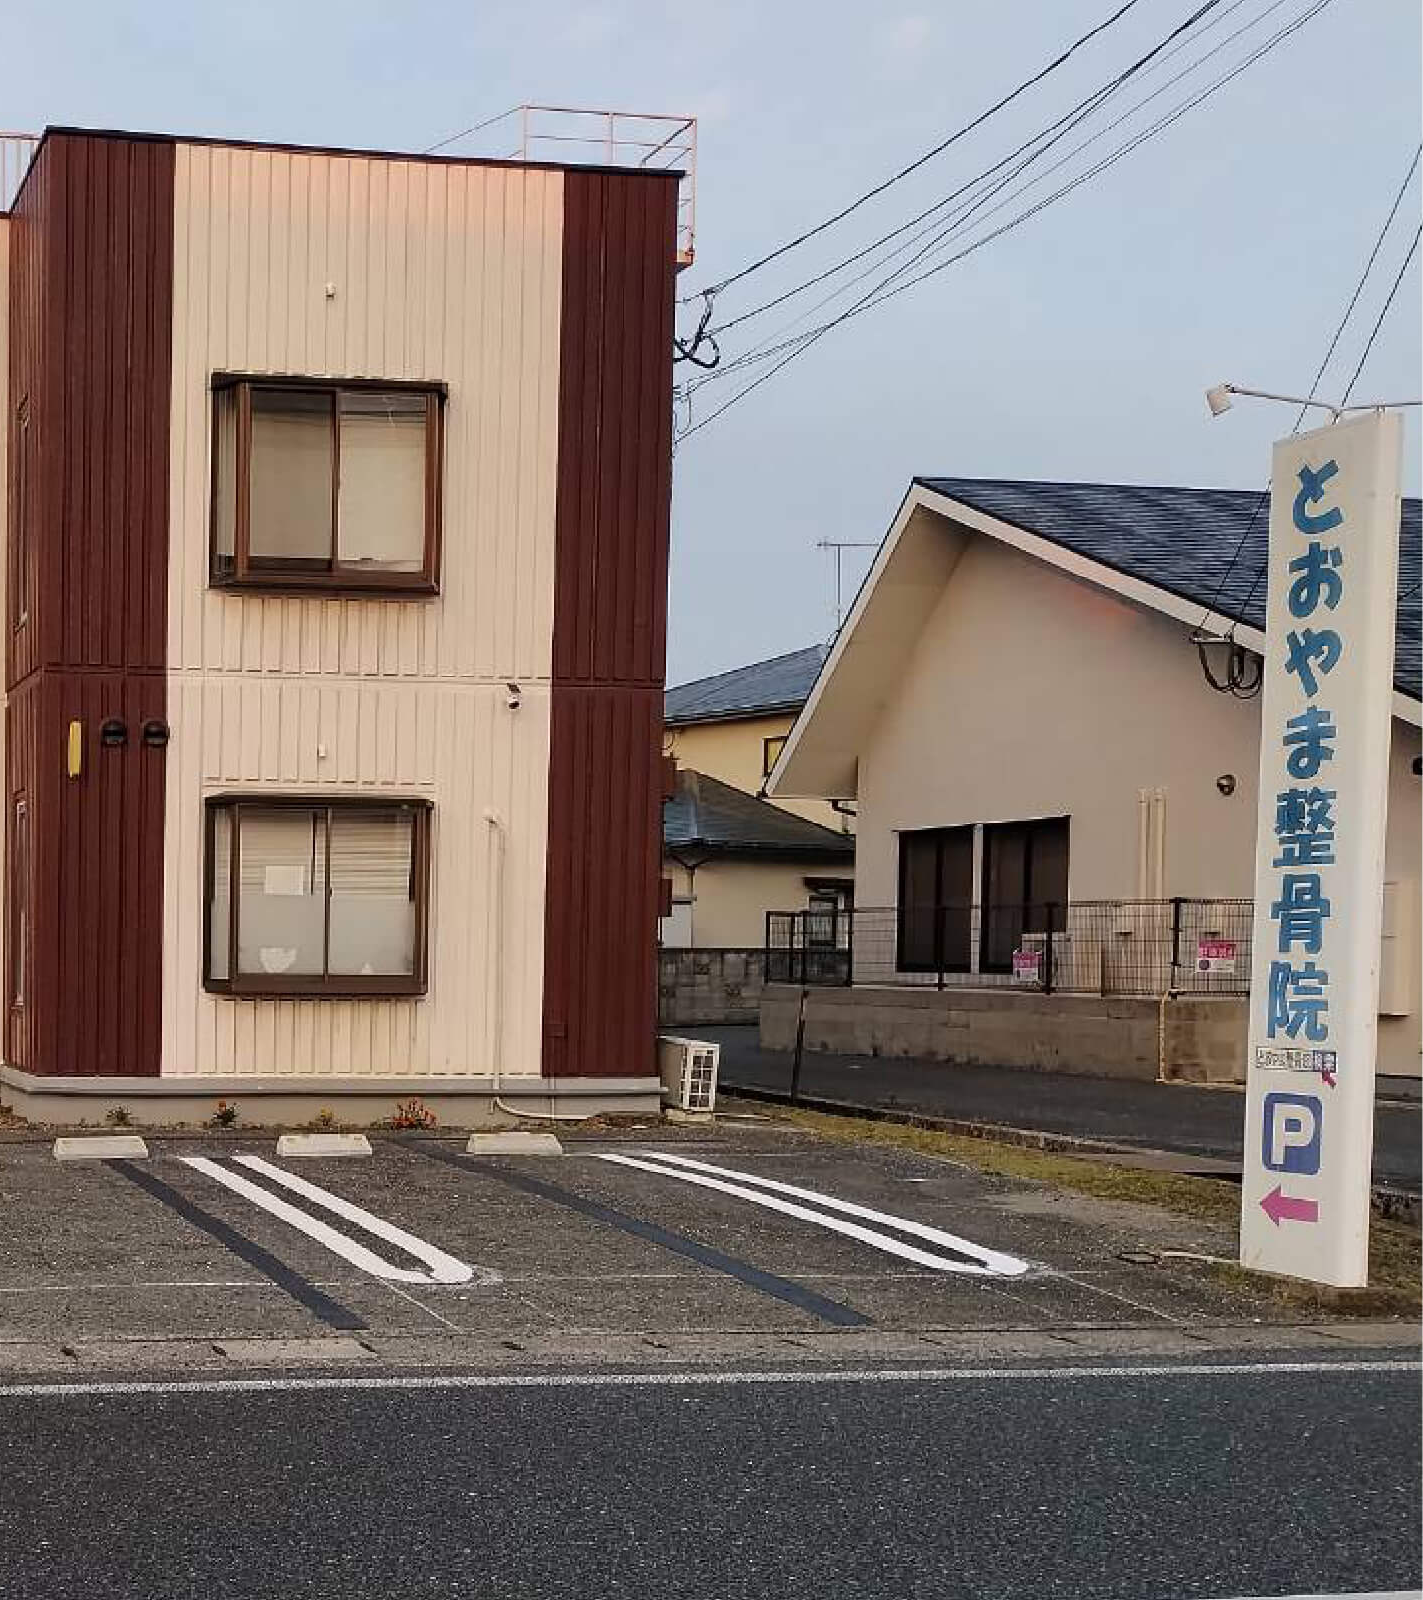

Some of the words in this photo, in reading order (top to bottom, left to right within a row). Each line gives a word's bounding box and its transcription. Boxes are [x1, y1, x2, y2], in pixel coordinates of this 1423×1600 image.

[1267, 458, 1344, 1041] とおやま整骨院
[1270, 1102, 1314, 1165] P
